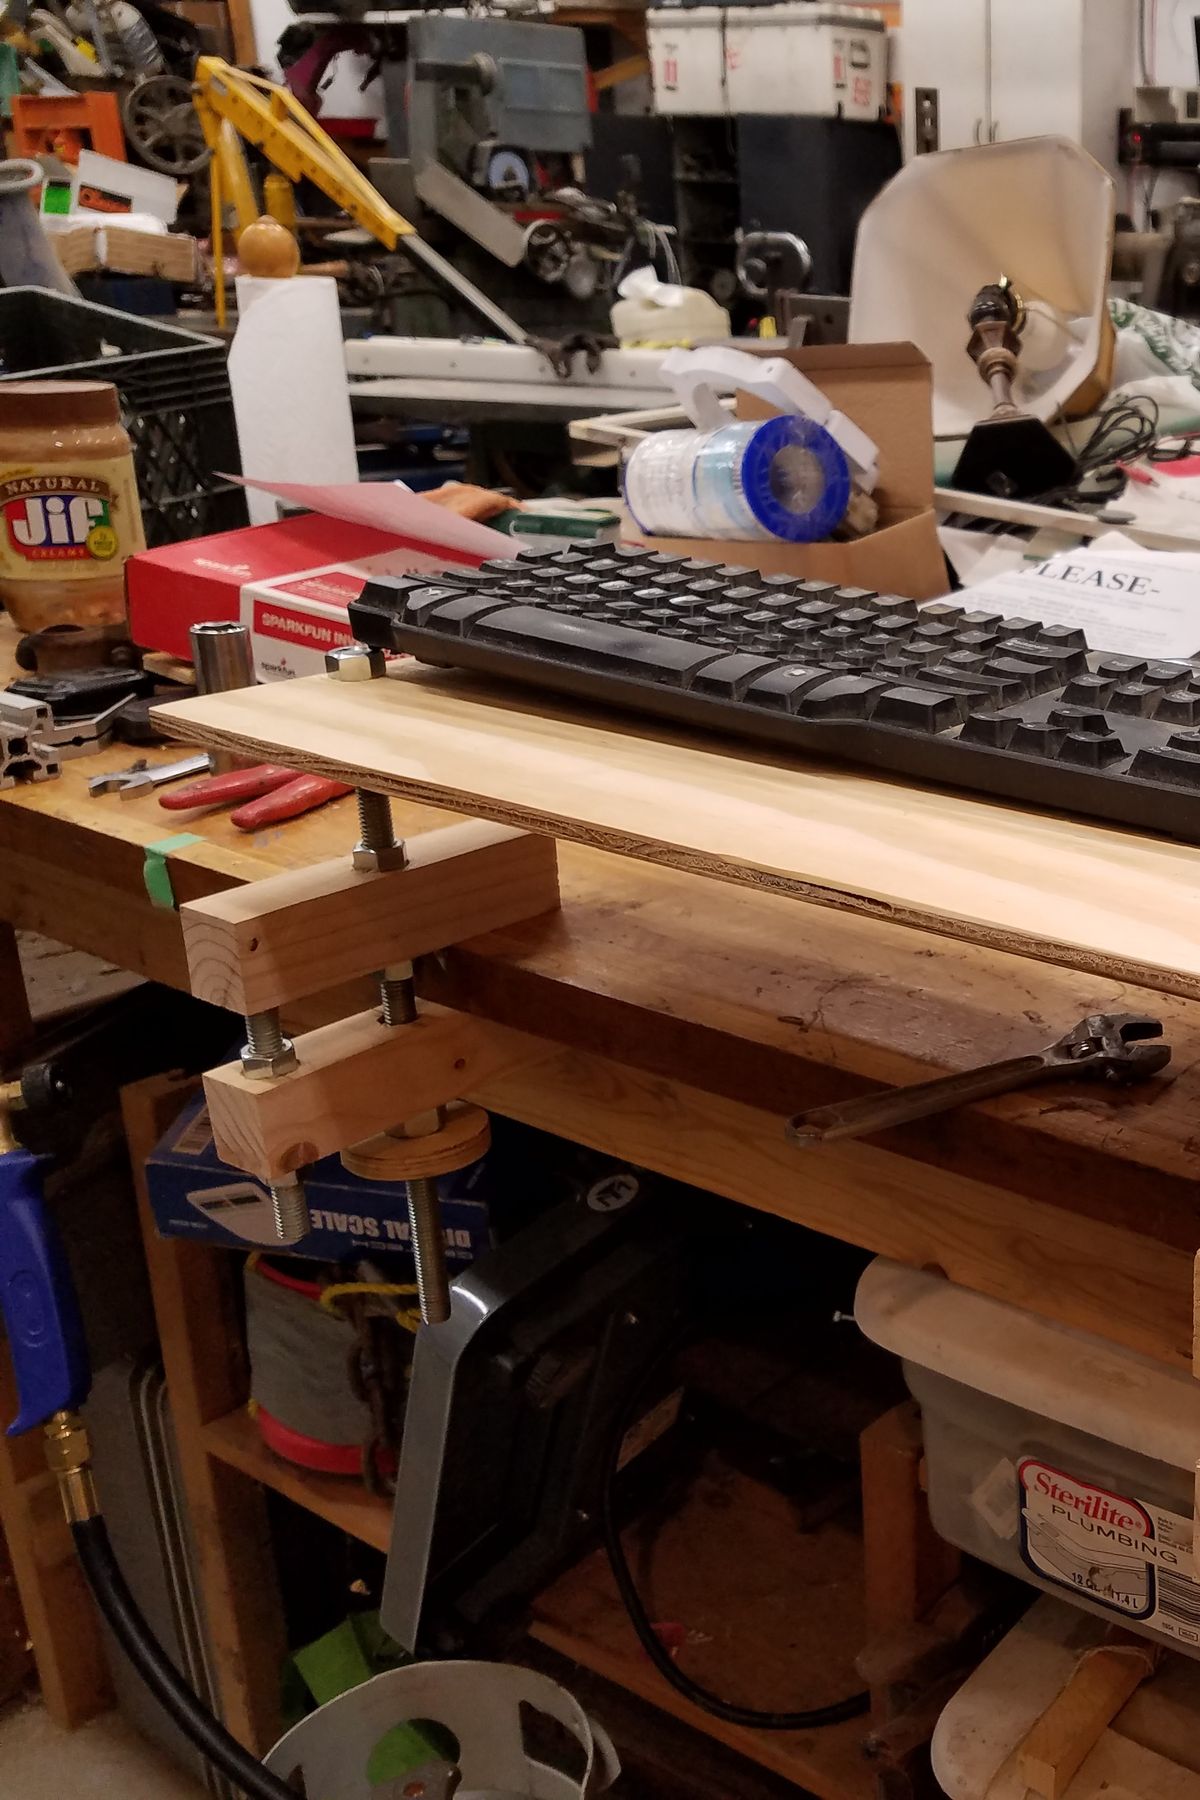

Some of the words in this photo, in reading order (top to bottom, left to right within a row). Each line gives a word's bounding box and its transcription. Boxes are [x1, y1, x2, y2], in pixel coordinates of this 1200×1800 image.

[5, 476, 101, 496] NATURAL
[12, 496, 104, 546] Jif
[261, 612, 331, 645] SPARKFUN
[309, 1208, 380, 1238] SCALE
[1034, 1472, 1134, 1531] Sterilite
[1052, 1504, 1178, 1565] PLUMBING
[1071, 1571, 1084, 1586] 12
